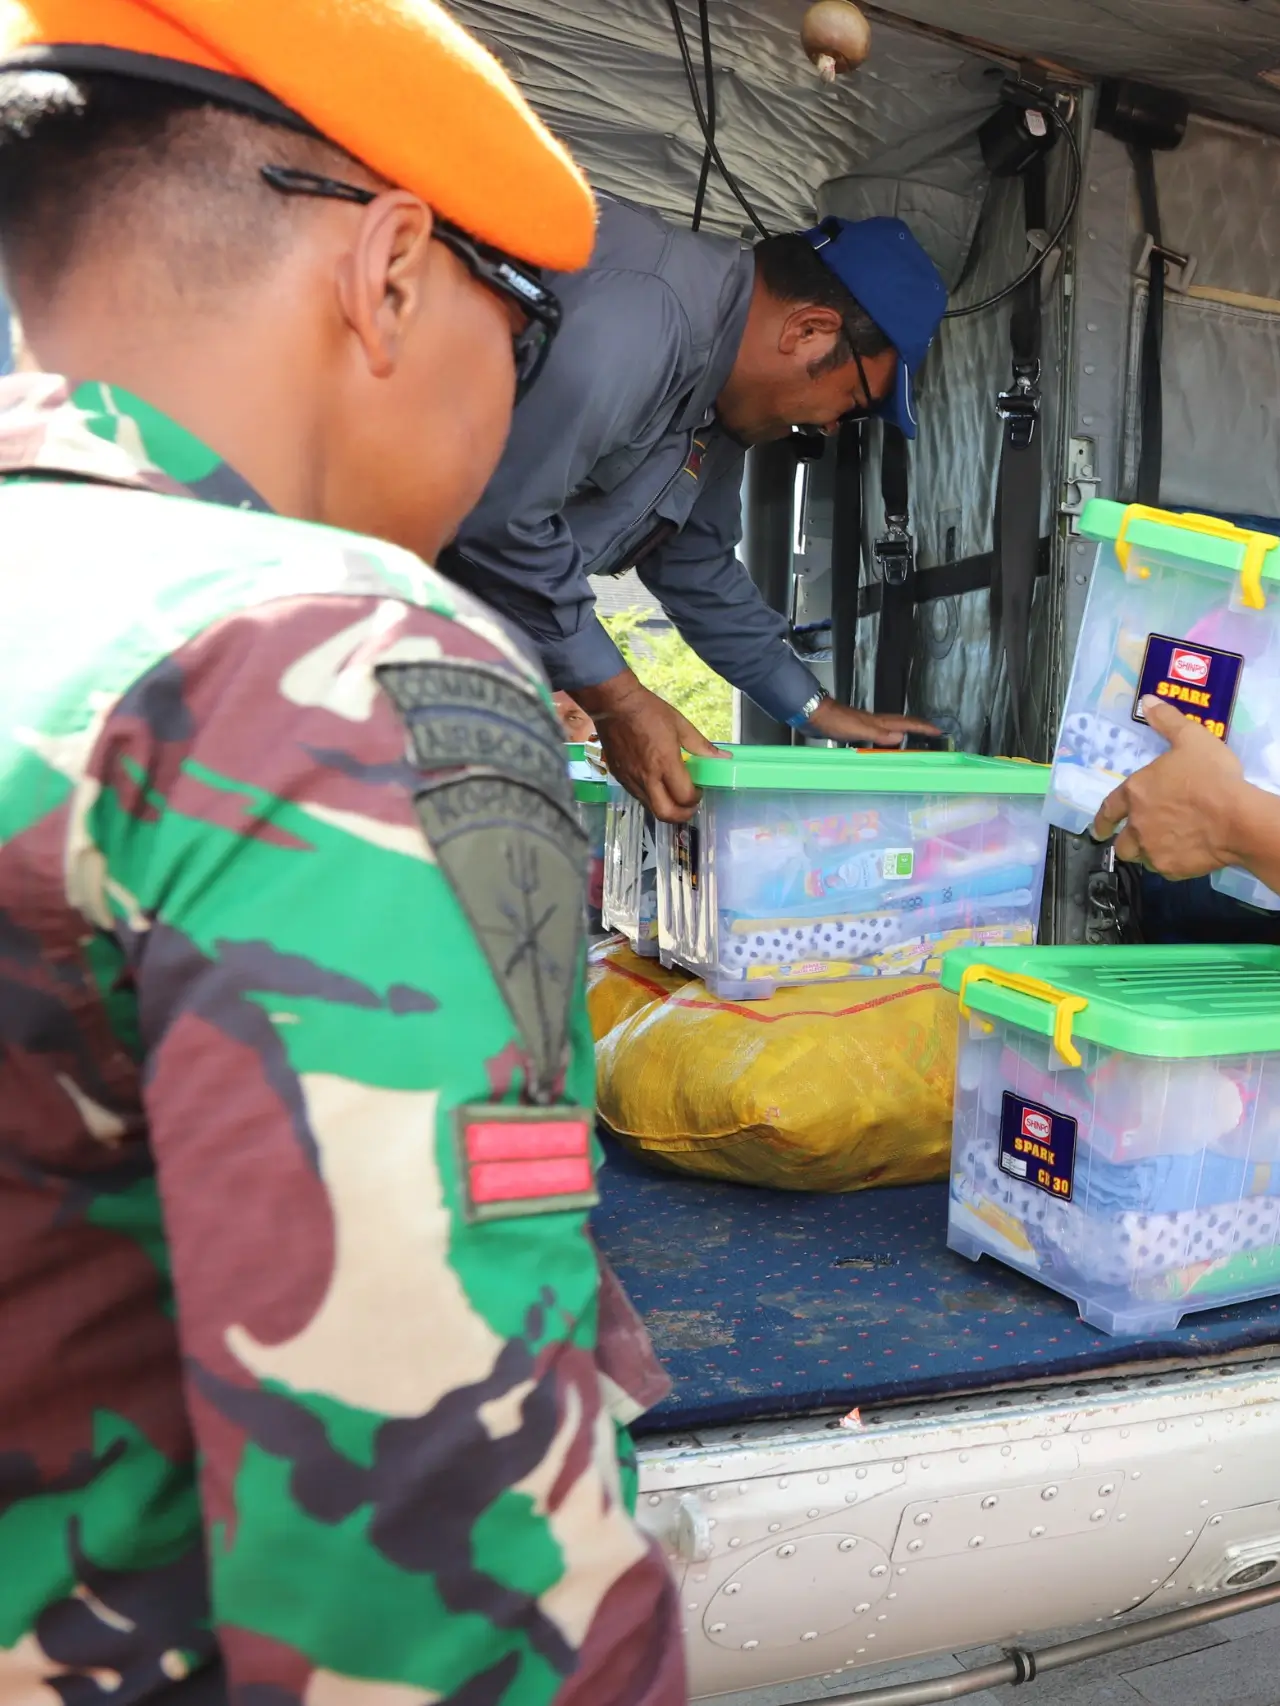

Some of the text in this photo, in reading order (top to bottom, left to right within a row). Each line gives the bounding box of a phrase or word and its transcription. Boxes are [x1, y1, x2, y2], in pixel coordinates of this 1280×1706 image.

[1176, 659, 1207, 676] SHINPO
[1157, 682, 1211, 707] SPARK
[1026, 1117, 1050, 1134] SHINPO
[1014, 1137, 1056, 1165] SPARK
[1053, 1177, 1069, 1194] 30
